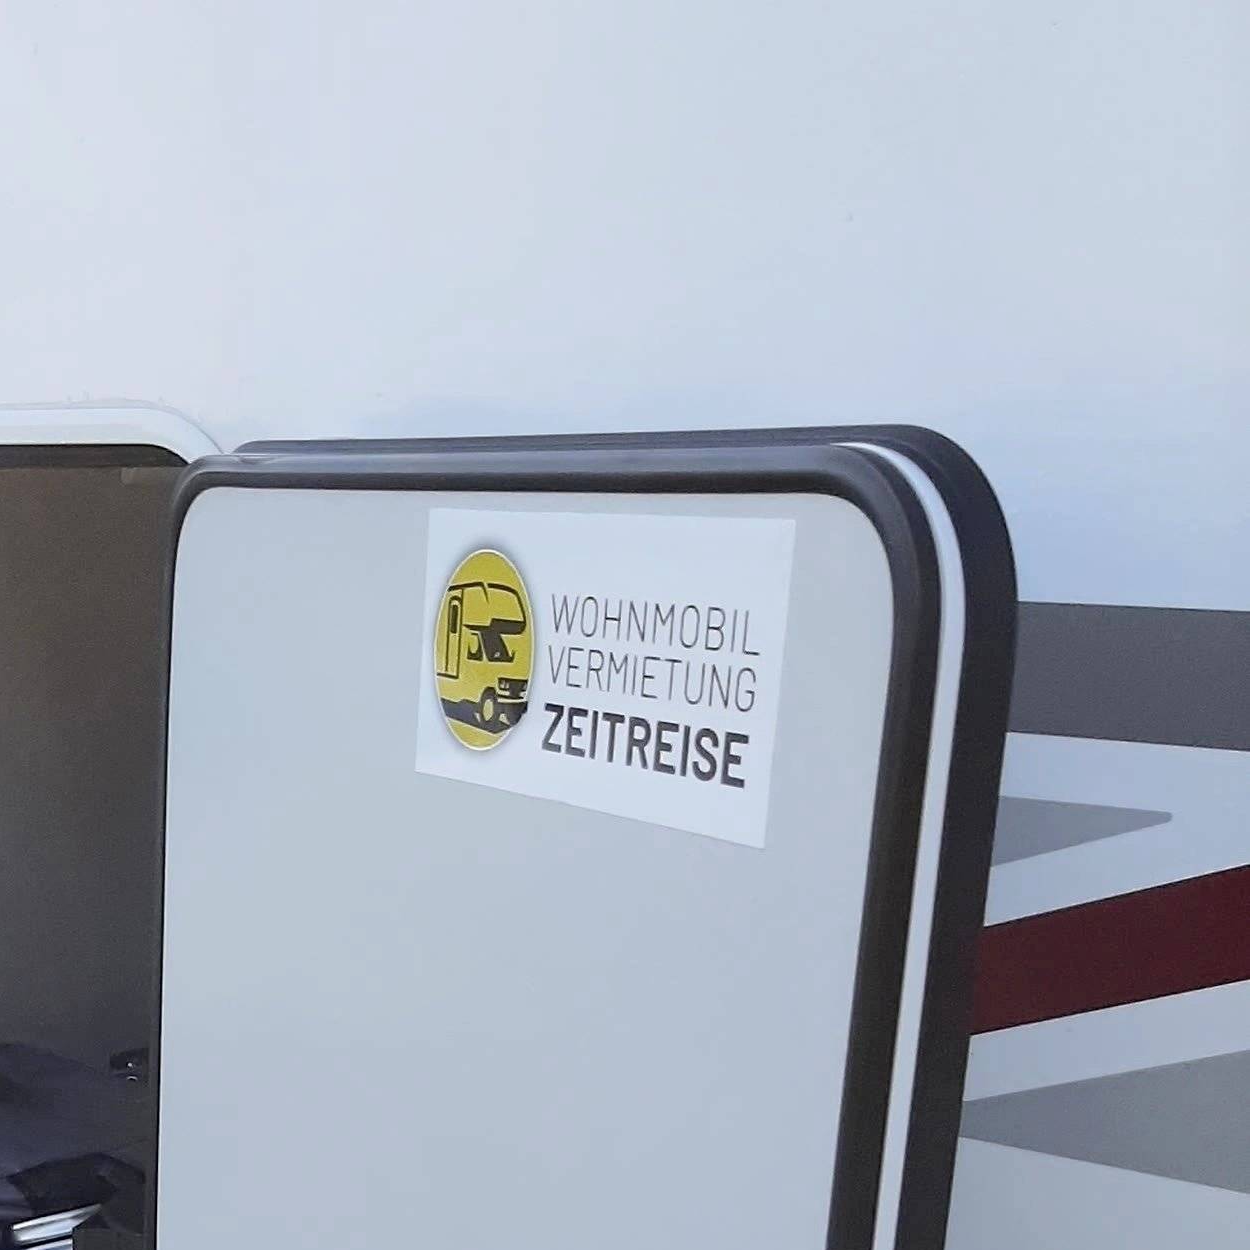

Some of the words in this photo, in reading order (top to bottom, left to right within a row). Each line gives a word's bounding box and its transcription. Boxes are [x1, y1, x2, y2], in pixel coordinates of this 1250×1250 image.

[551, 594, 760, 656] WOHNMOBIL
[548, 645, 757, 712] VERMIETUNG
[542, 703, 750, 789] ZEITREISE
